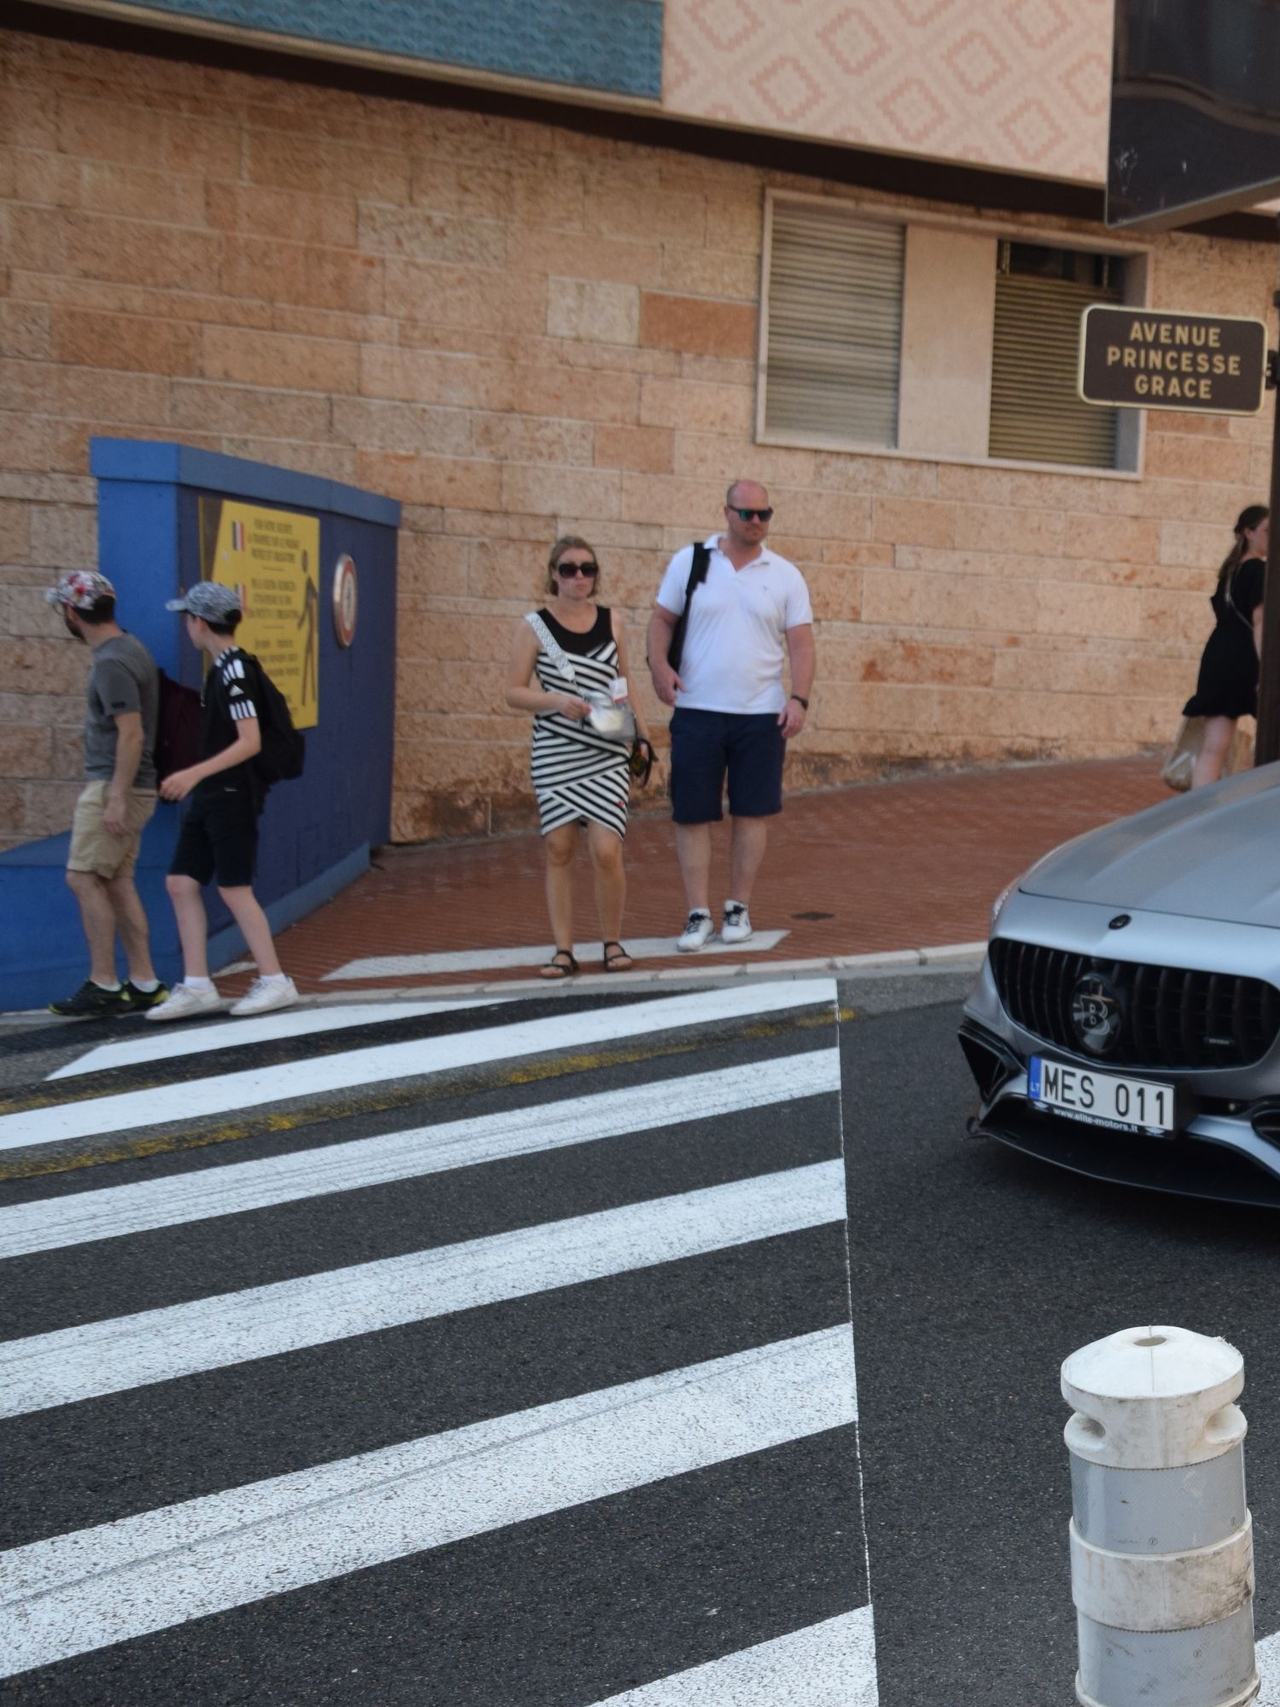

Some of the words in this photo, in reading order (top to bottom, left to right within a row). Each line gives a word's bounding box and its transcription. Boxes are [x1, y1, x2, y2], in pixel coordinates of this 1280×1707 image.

[1129, 321, 1221, 347] AVENUE
[1106, 346, 1241, 376] PRINCESSE
[1134, 374, 1213, 400] GRACE
[1030, 1082, 1041, 1093] LT
[1044, 1065, 1095, 1109] MES
[1115, 1083, 1165, 1126] 011
[1053, 1107, 1139, 1133] www.elite-motors.lt
